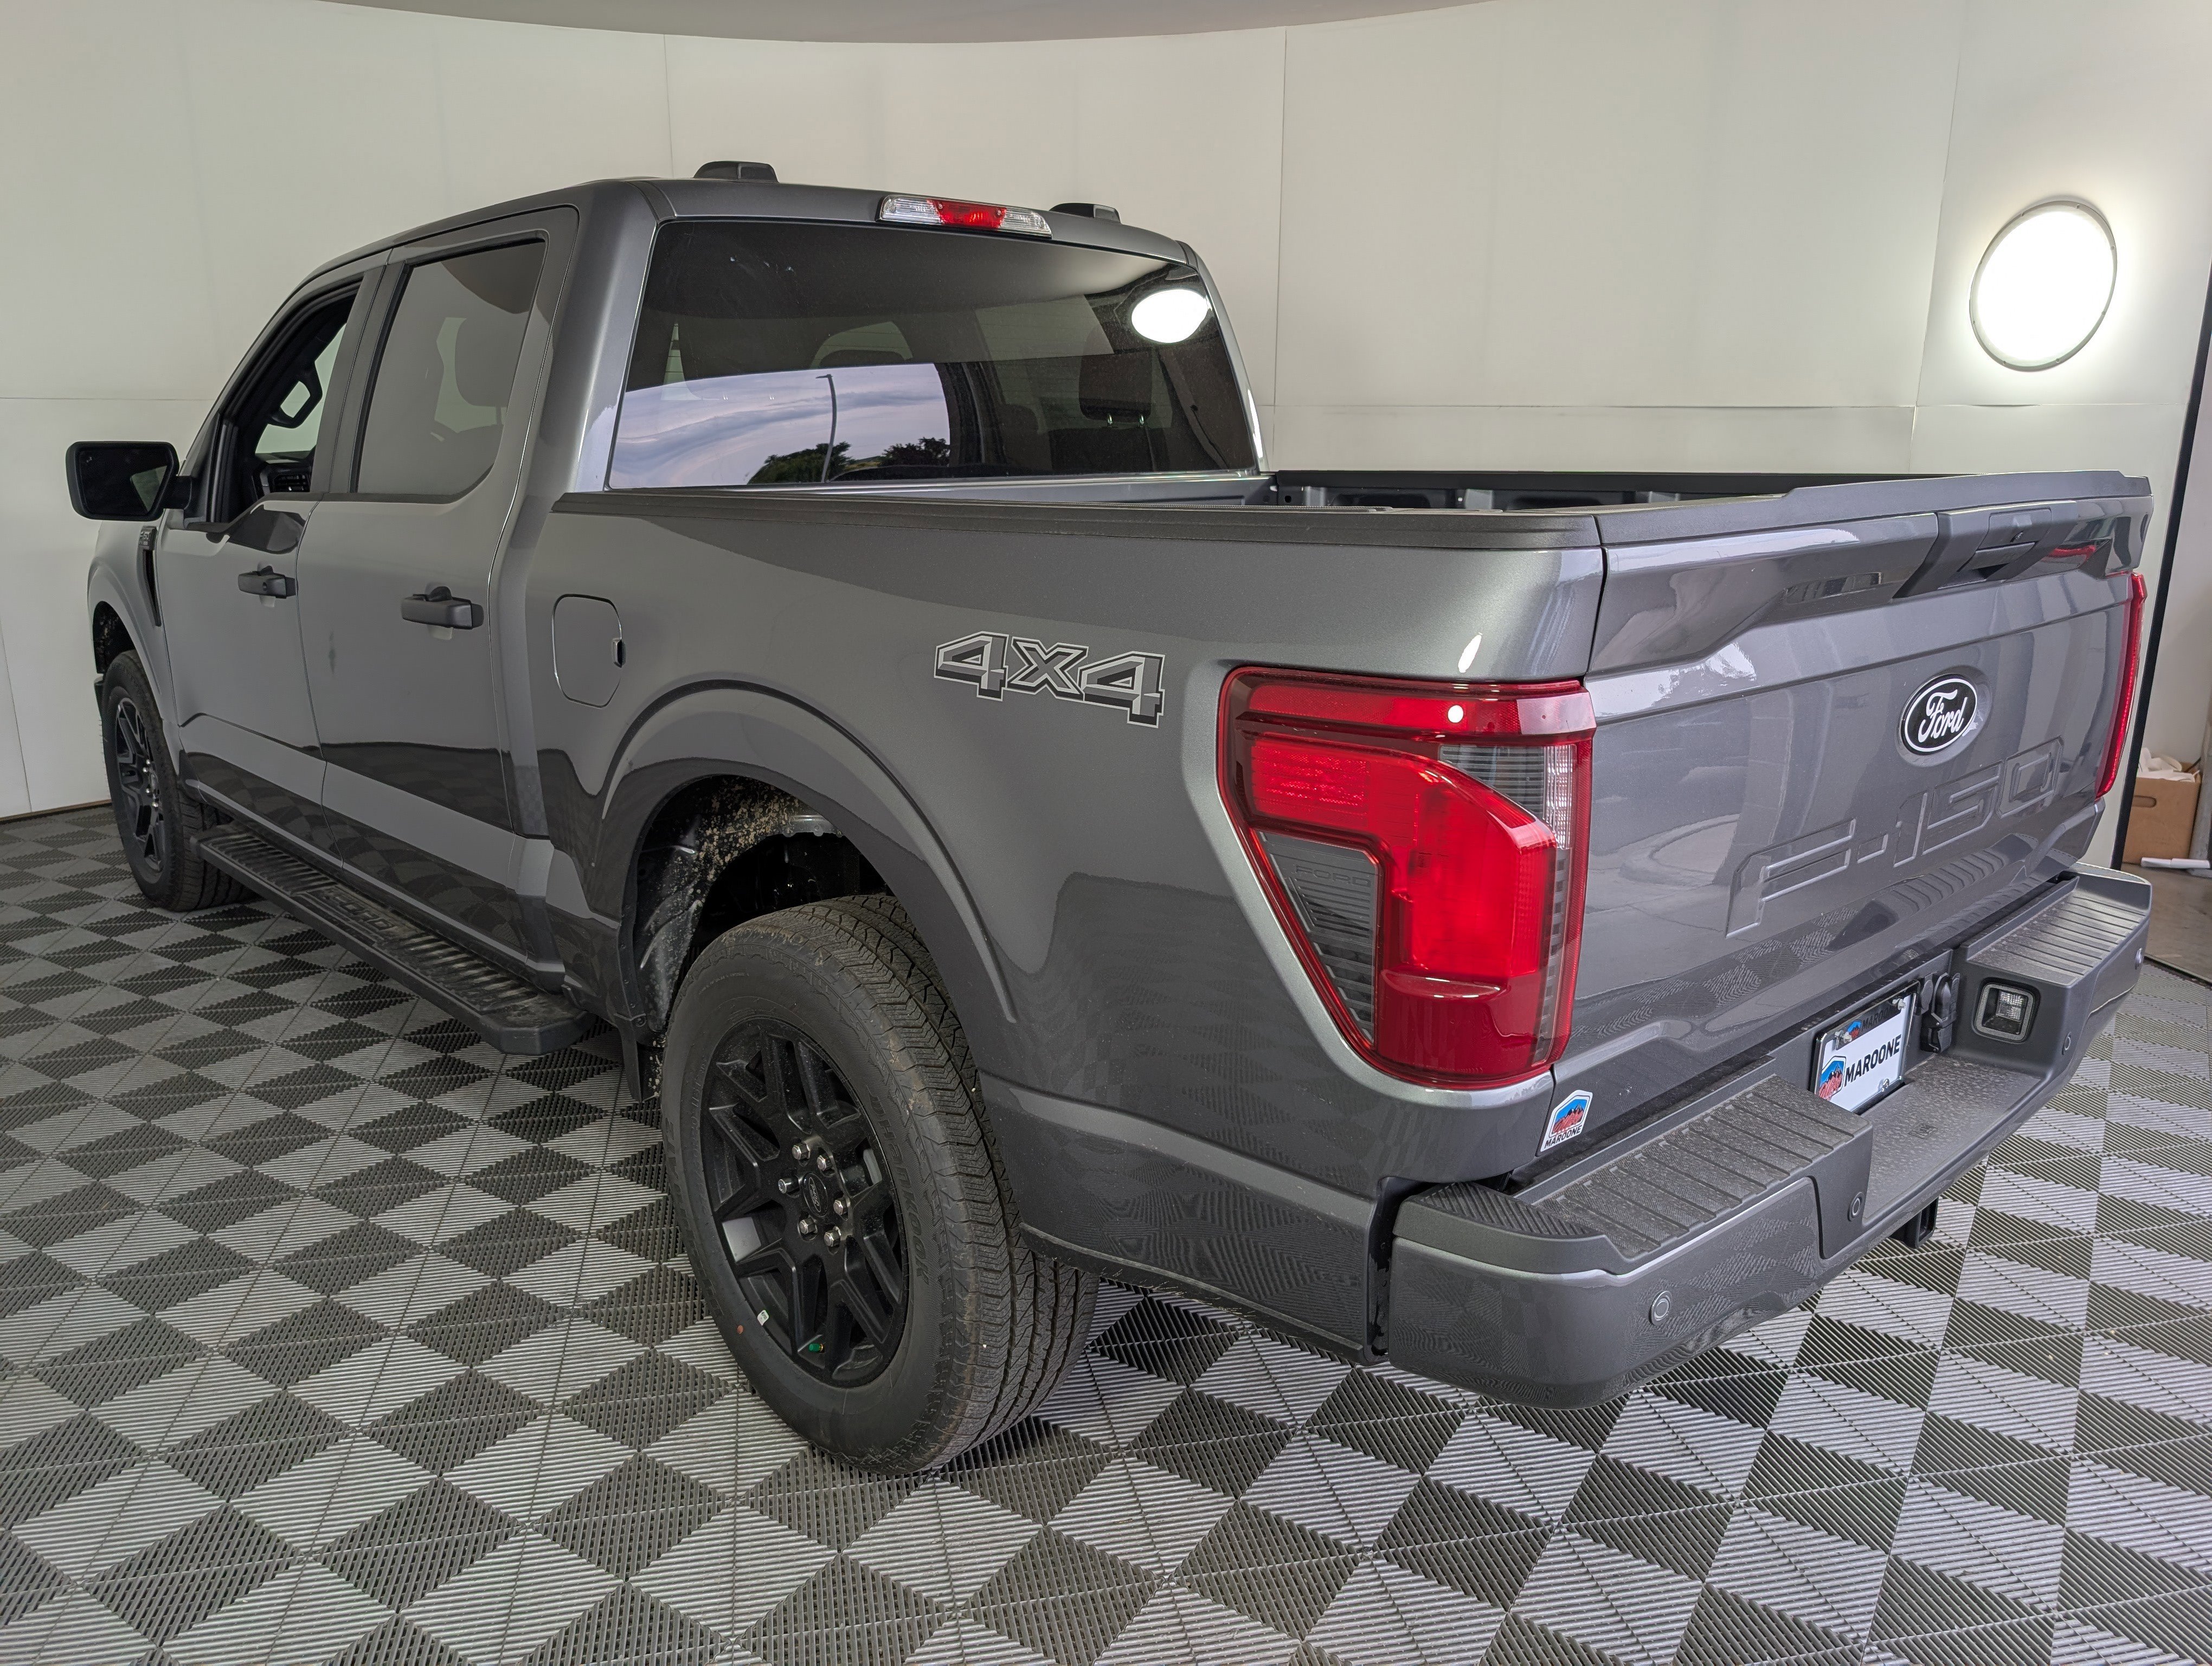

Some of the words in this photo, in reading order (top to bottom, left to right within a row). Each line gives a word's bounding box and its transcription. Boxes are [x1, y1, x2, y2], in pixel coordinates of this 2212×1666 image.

[934, 630, 1166, 728] 4X4
[1918, 689, 1968, 743] Ford
[1725, 735, 2065, 939] F-150
[1296, 865, 1372, 887] FORD
[1844, 1034, 1902, 1087] MAROONE
[1544, 1125, 1583, 1149] MAROONE
